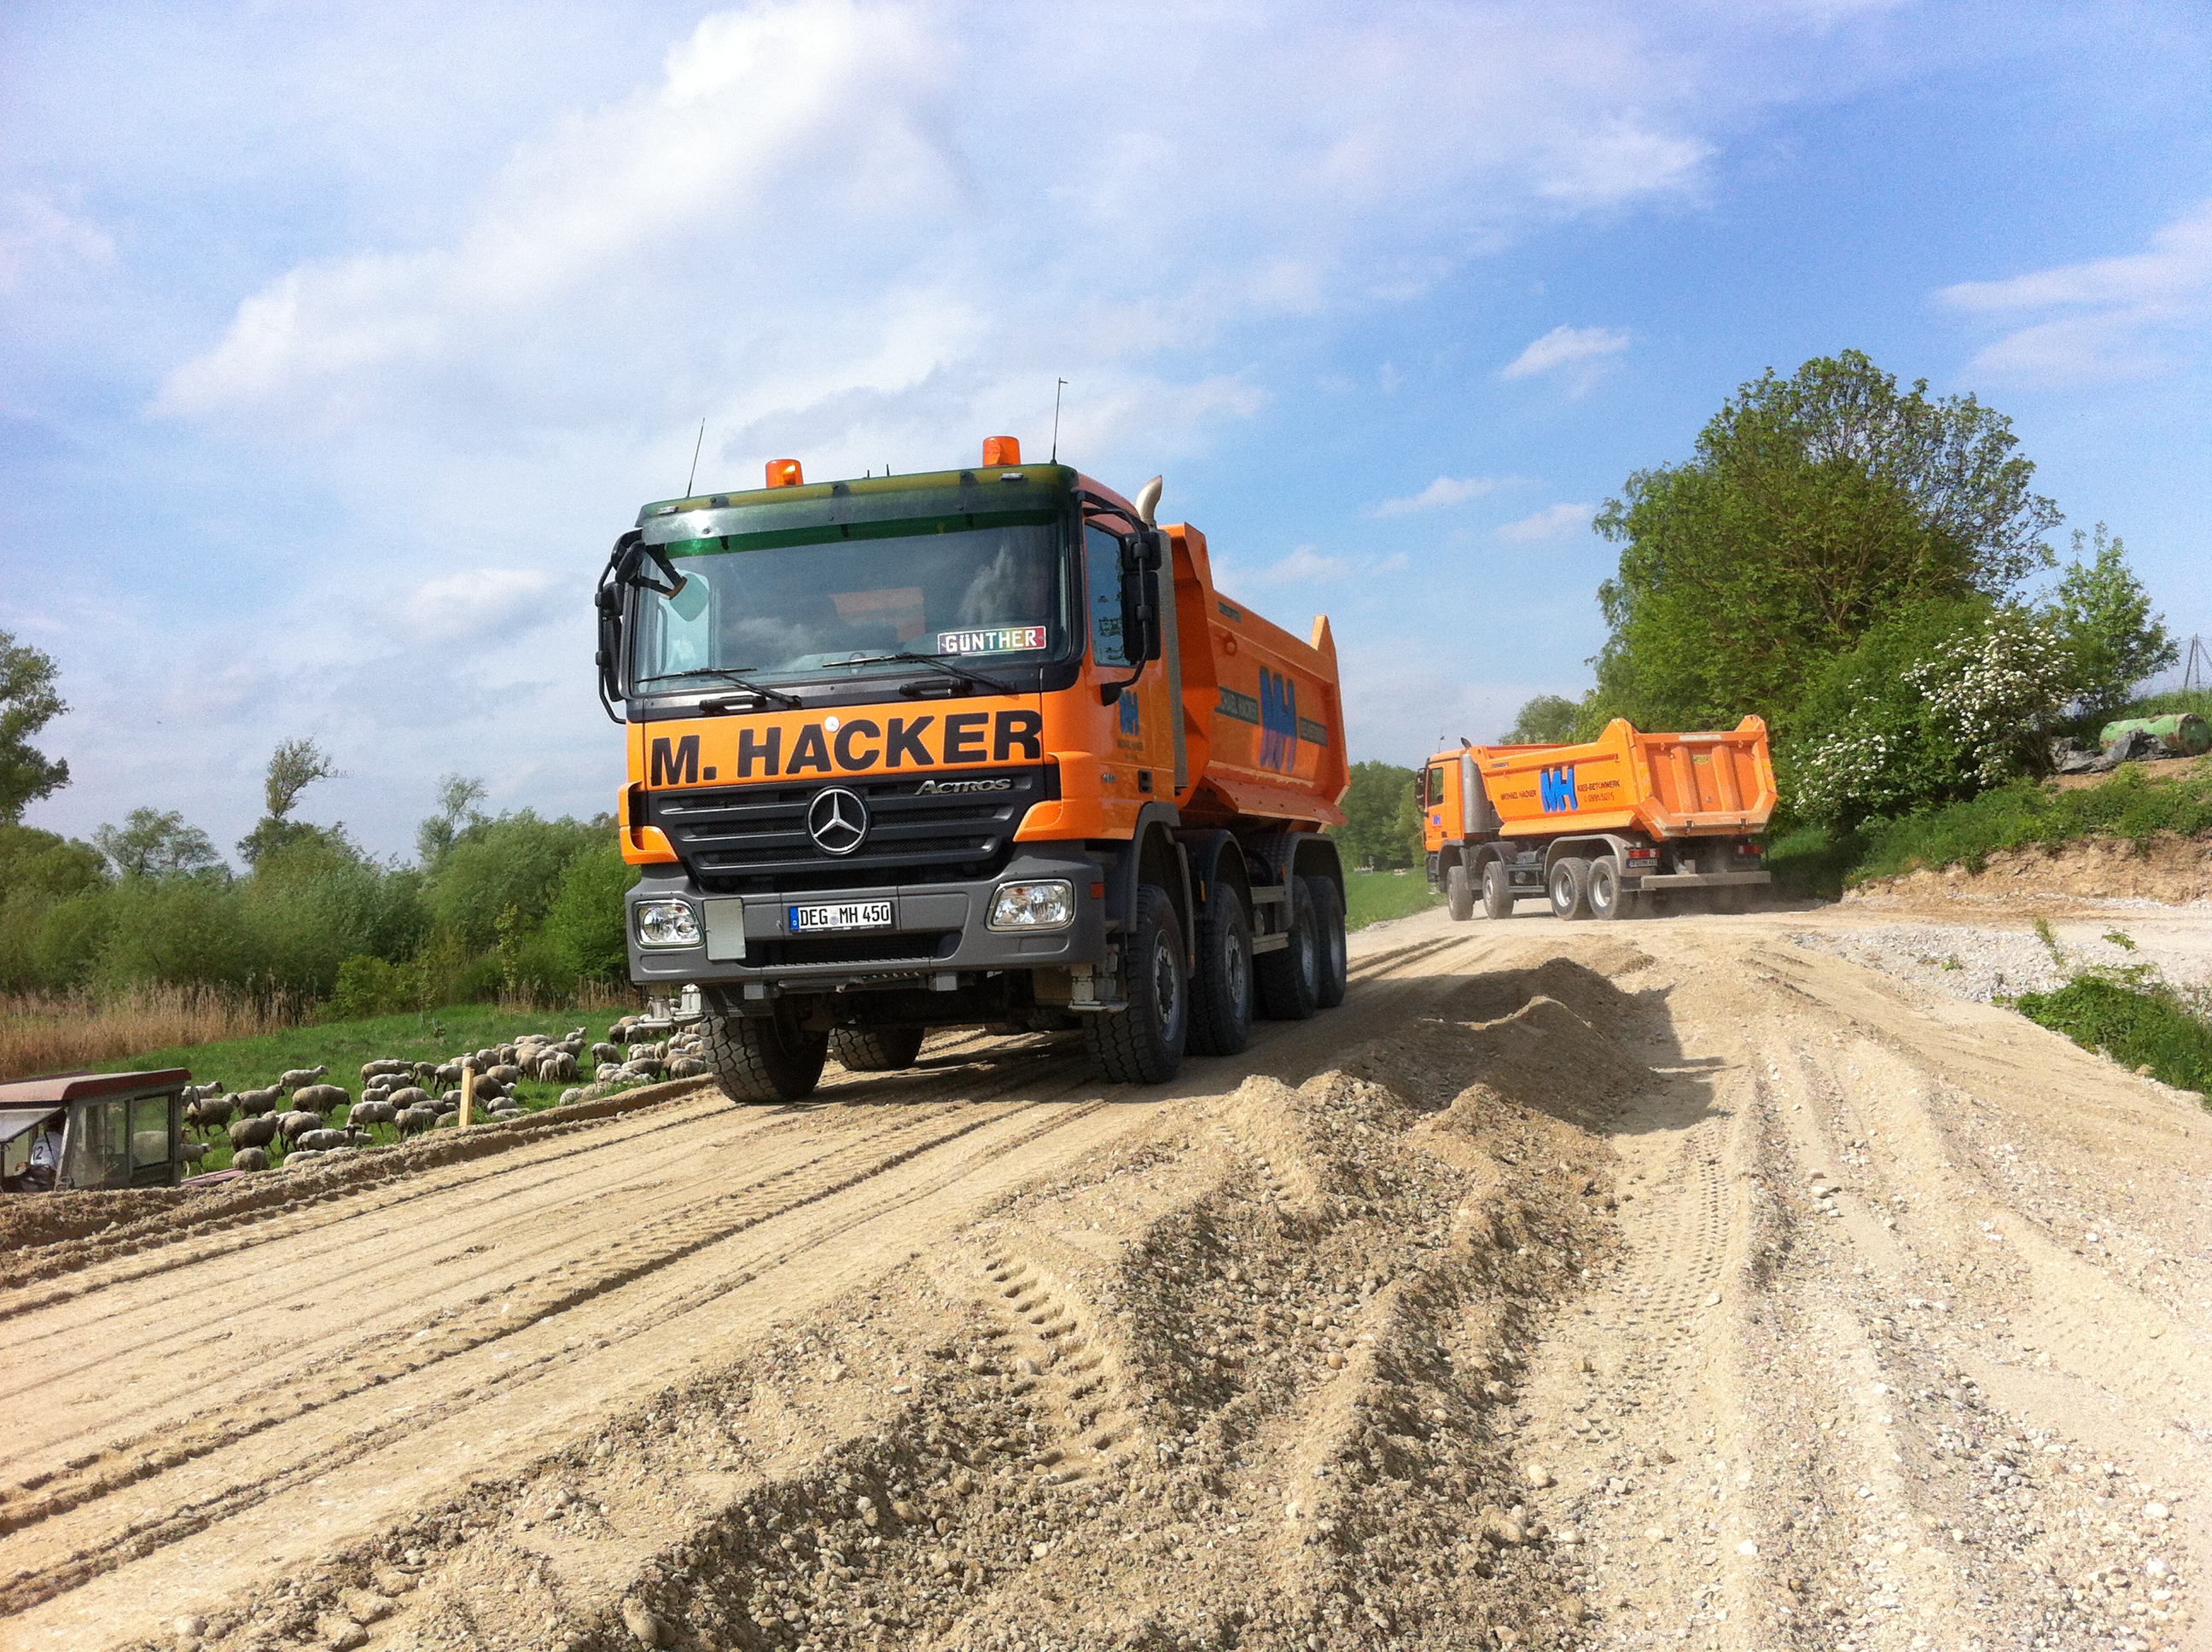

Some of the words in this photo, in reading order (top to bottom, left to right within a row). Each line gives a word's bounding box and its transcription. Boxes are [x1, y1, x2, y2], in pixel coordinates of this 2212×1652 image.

[946, 630, 1037, 653] GÜNTHER
[650, 735, 718, 787] M.
[736, 709, 1042, 778] HACKER
[800, 909, 829, 926] DEG
[839, 906, 859, 924] MH
[862, 905, 890, 922] 450
